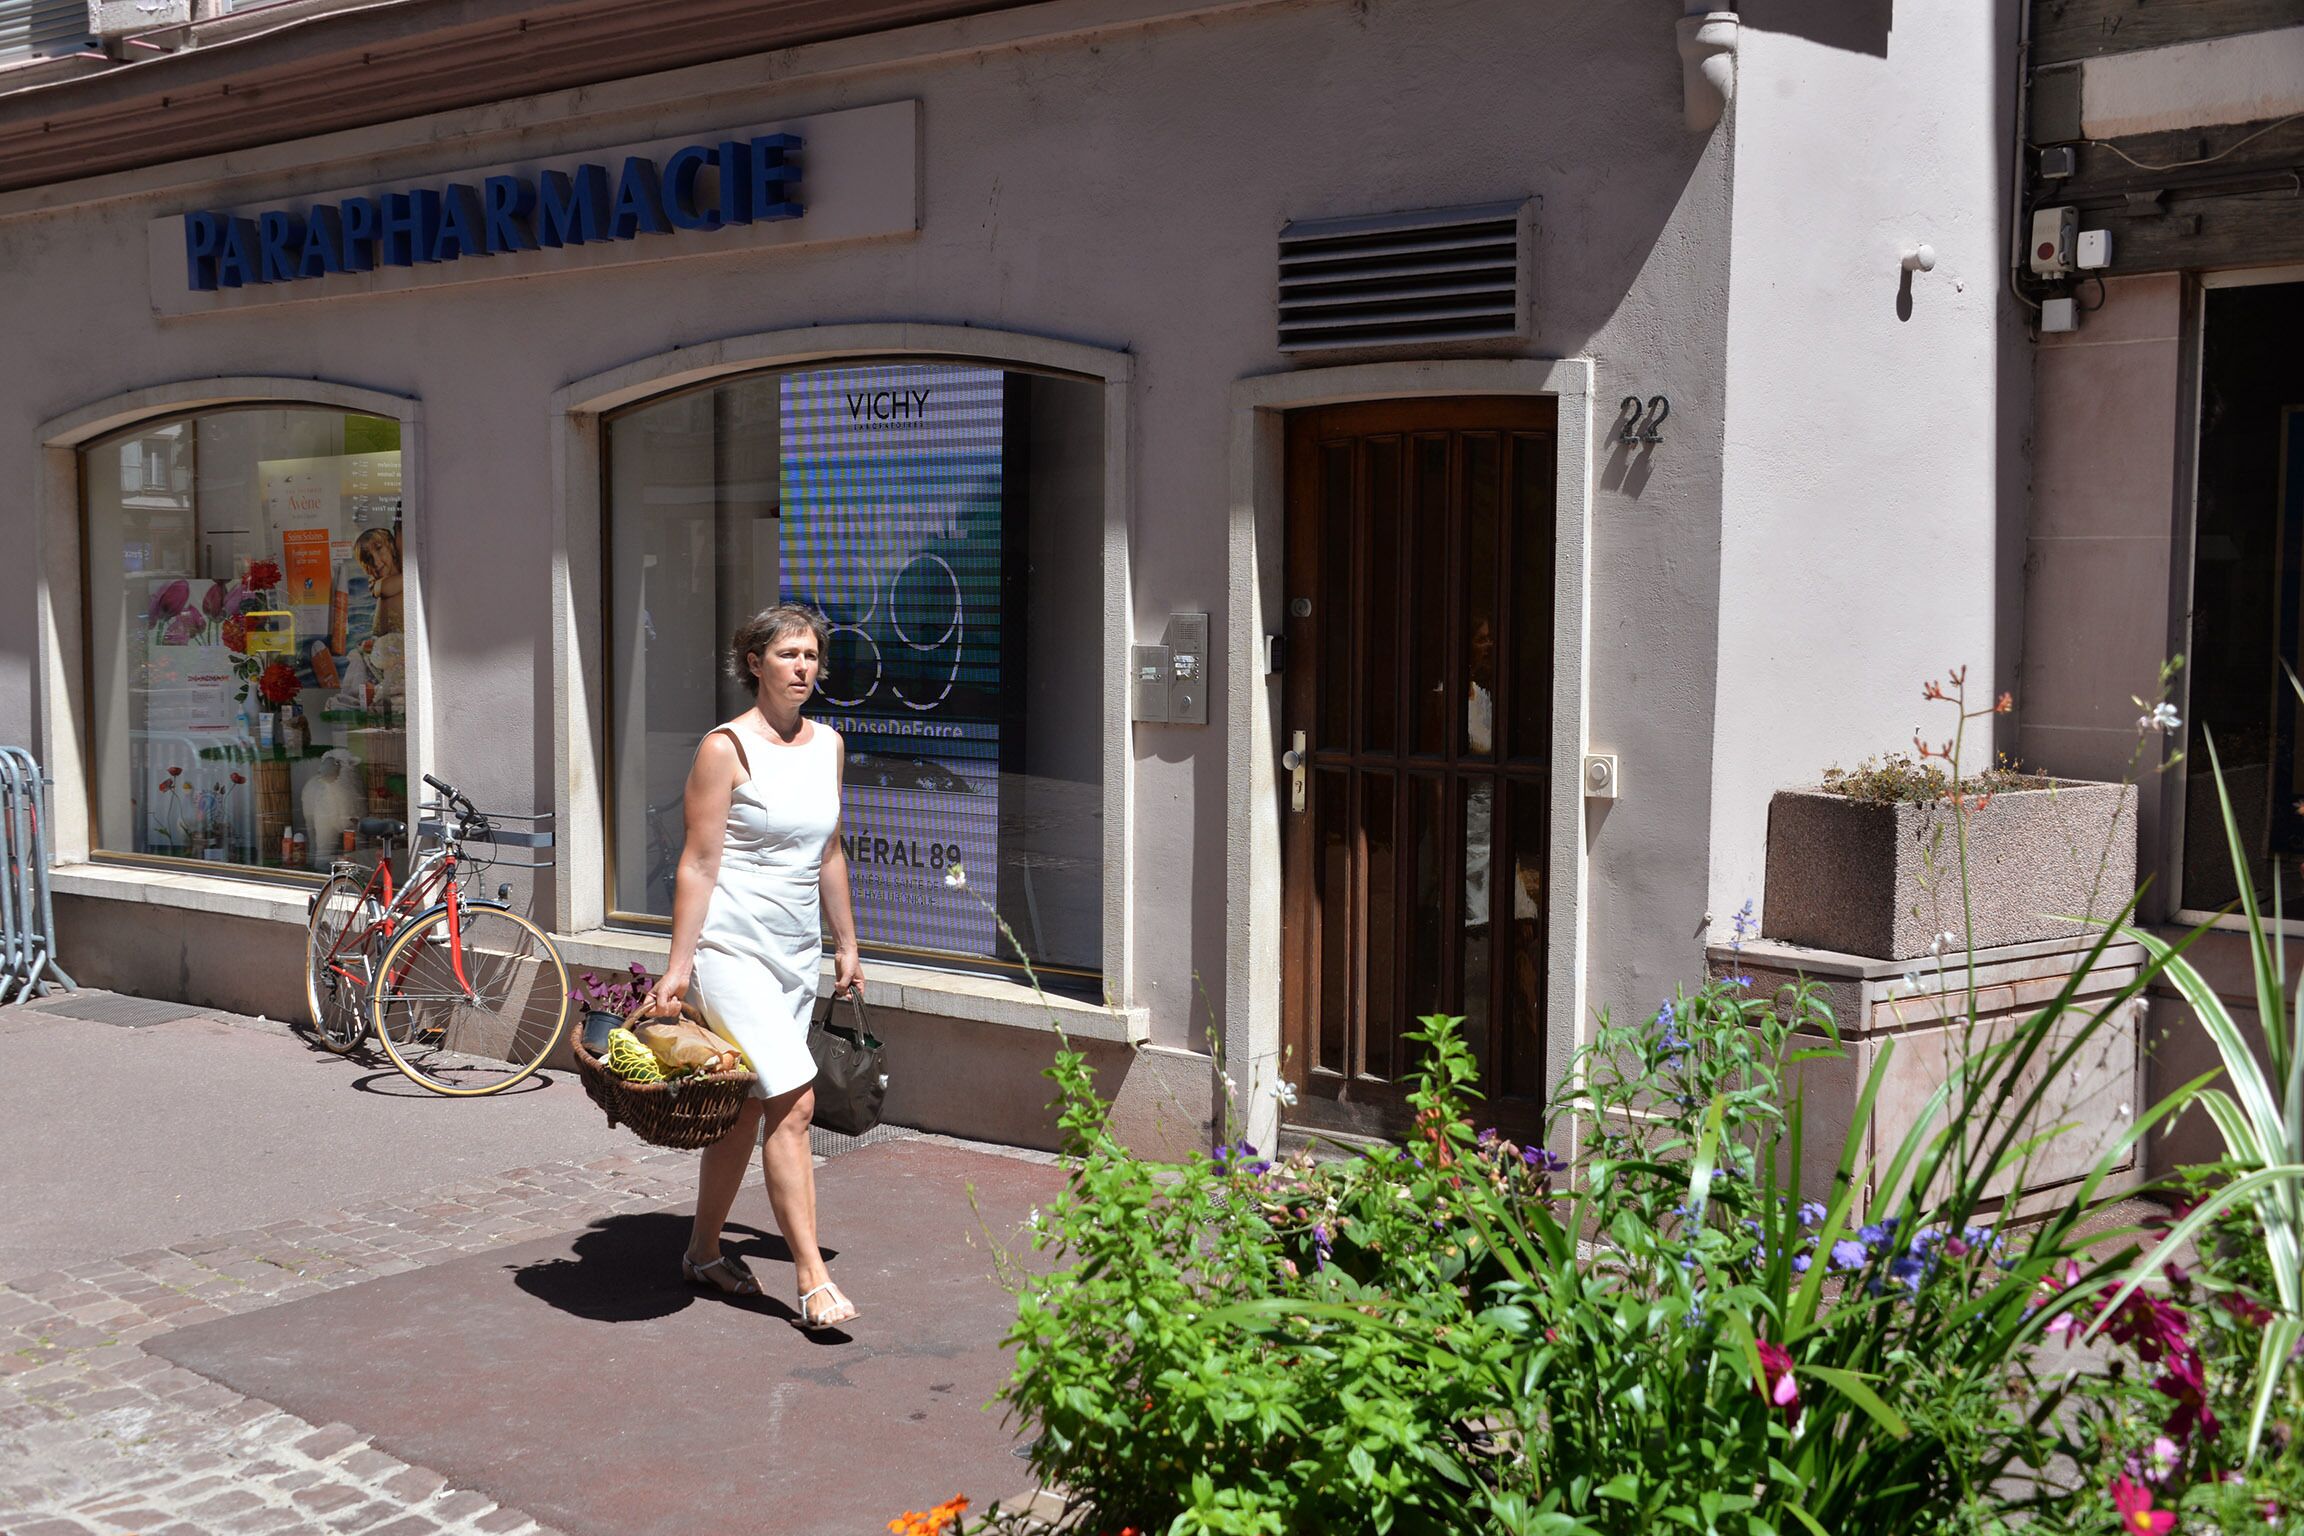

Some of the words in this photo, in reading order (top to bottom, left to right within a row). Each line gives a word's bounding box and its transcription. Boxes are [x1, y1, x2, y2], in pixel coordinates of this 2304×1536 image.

[184, 132, 806, 291] PARAPHARMACIE
[846, 389, 930, 420] VICHY
[1620, 395, 1669, 443] 22
[840, 829, 925, 868] NÉRAL
[930, 843, 961, 870] 89
